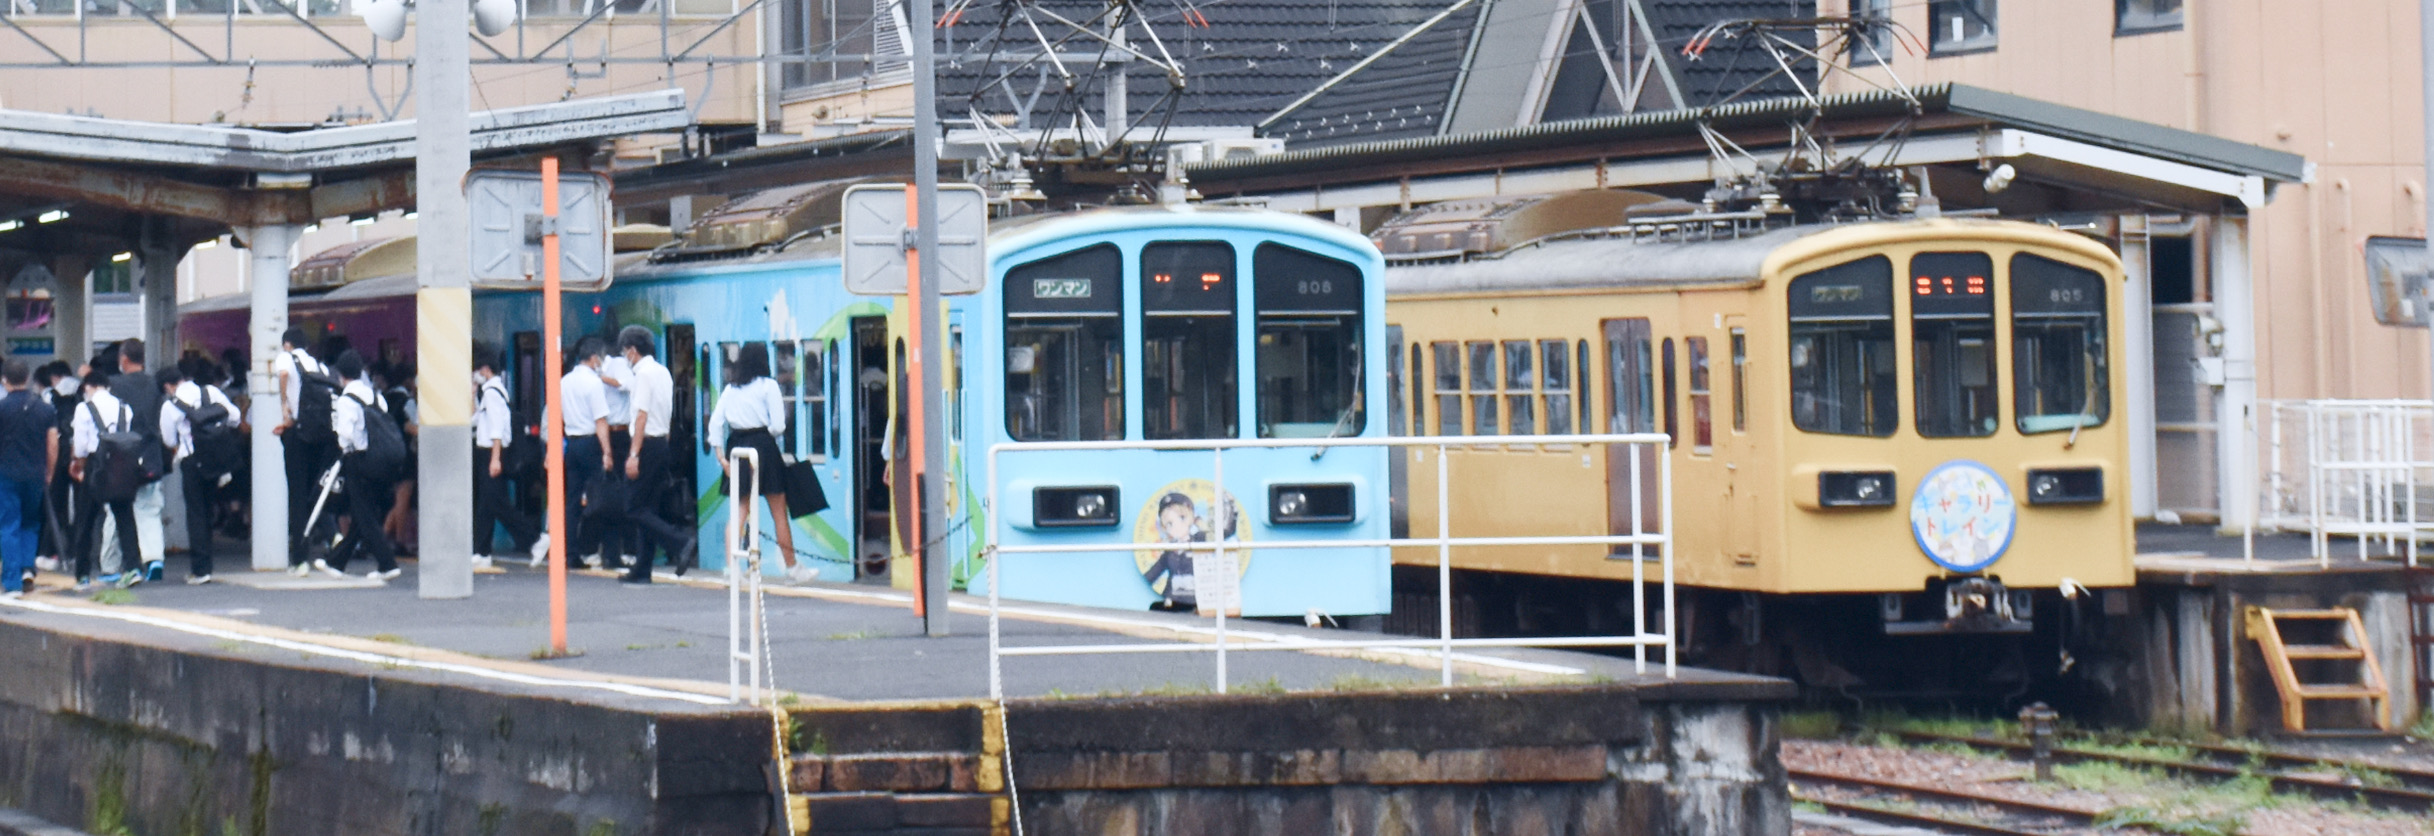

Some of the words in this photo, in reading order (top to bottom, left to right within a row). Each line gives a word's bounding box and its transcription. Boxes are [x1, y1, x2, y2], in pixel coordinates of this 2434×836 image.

[1037, 280, 1088, 296] ワンマン
[1927, 516, 2000, 536] トレイン
